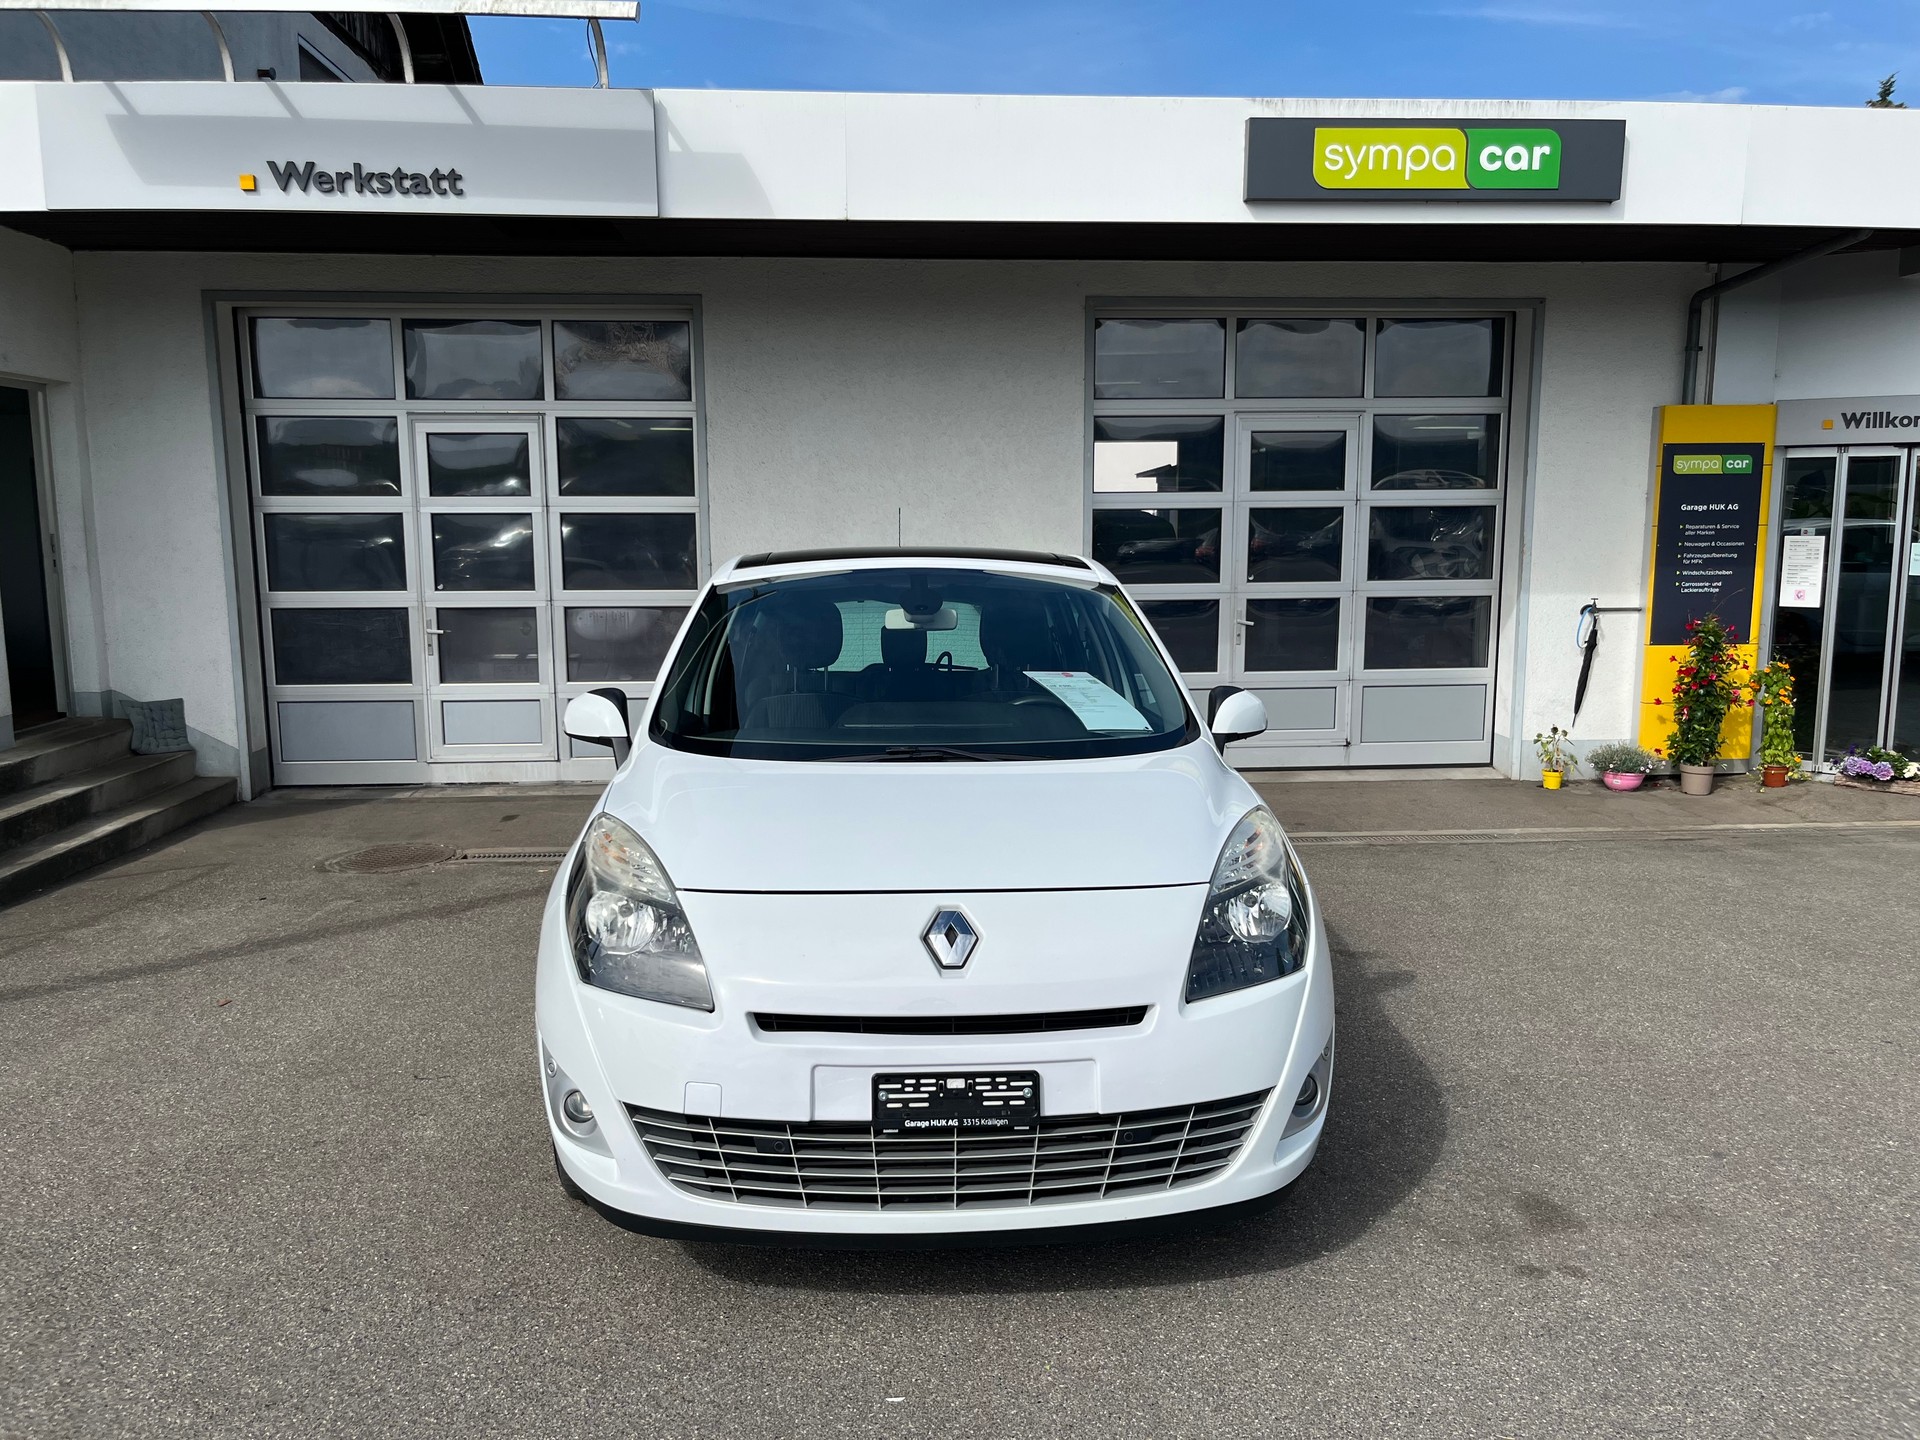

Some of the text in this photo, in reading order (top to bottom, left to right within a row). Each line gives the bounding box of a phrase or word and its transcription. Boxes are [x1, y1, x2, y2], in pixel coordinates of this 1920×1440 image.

[1324, 143, 1550, 180] sympa car
[266, 160, 464, 195] Werkstatt
[1676, 459, 1749, 472] sympa car
[1680, 503, 1739, 512] Garage HUK AG
[904, 1119, 930, 1128] Garage
[930, 1119, 947, 1127] HUK
[947, 1118, 959, 1126] AG
[962, 1118, 980, 1126] 3315
